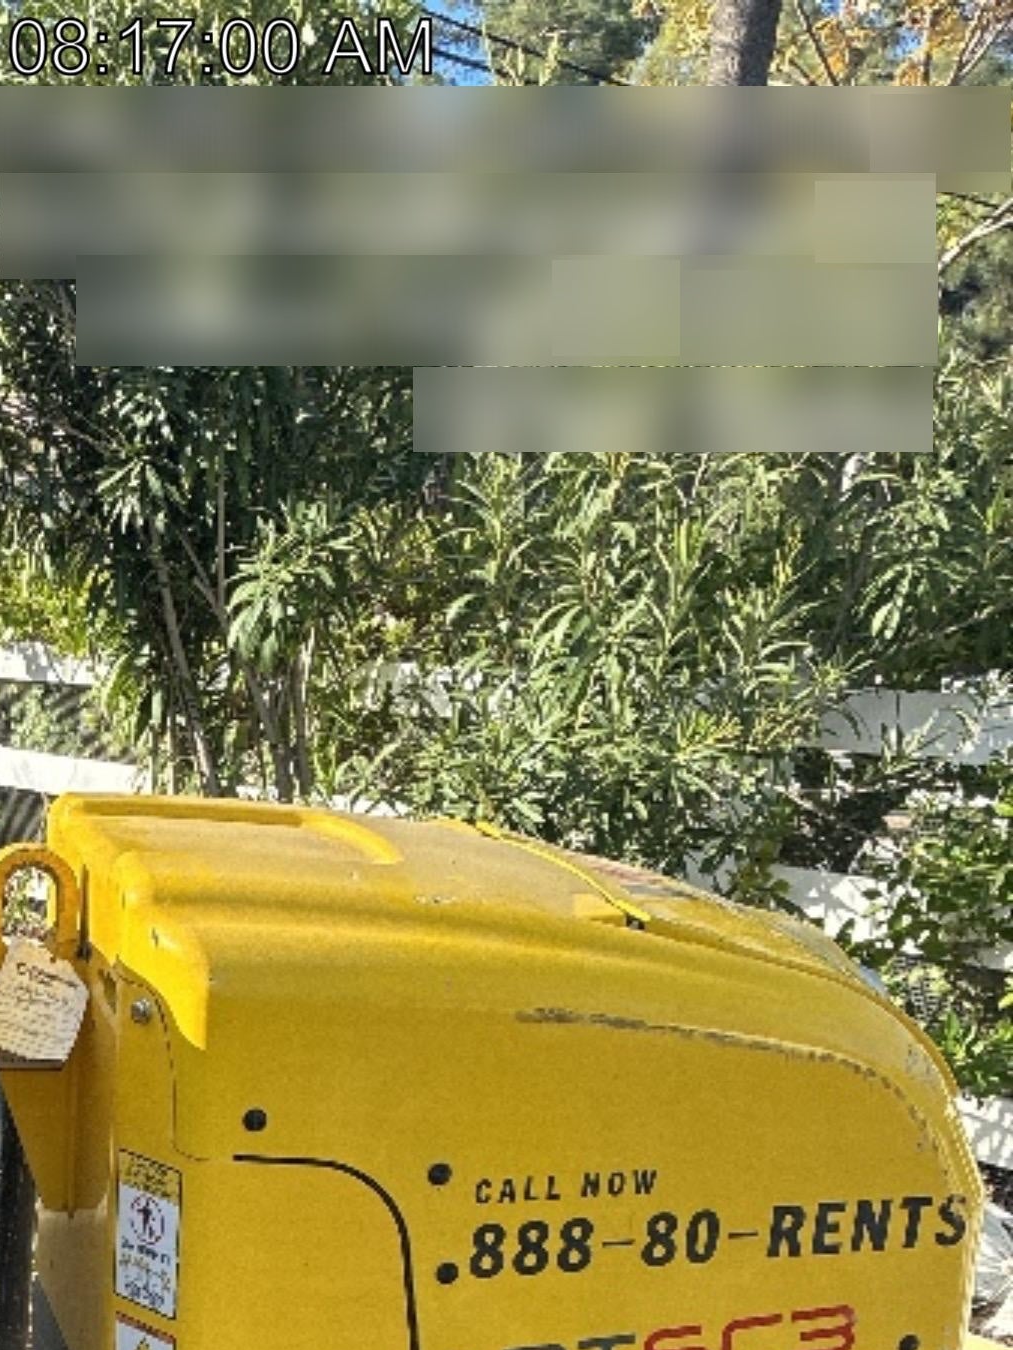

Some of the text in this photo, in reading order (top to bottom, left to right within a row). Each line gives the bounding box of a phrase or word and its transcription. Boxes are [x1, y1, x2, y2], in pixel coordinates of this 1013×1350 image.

[475, 1169, 658, 1204] CALL NOW
[469, 1193, 968, 1279] 888-80-RENTS
